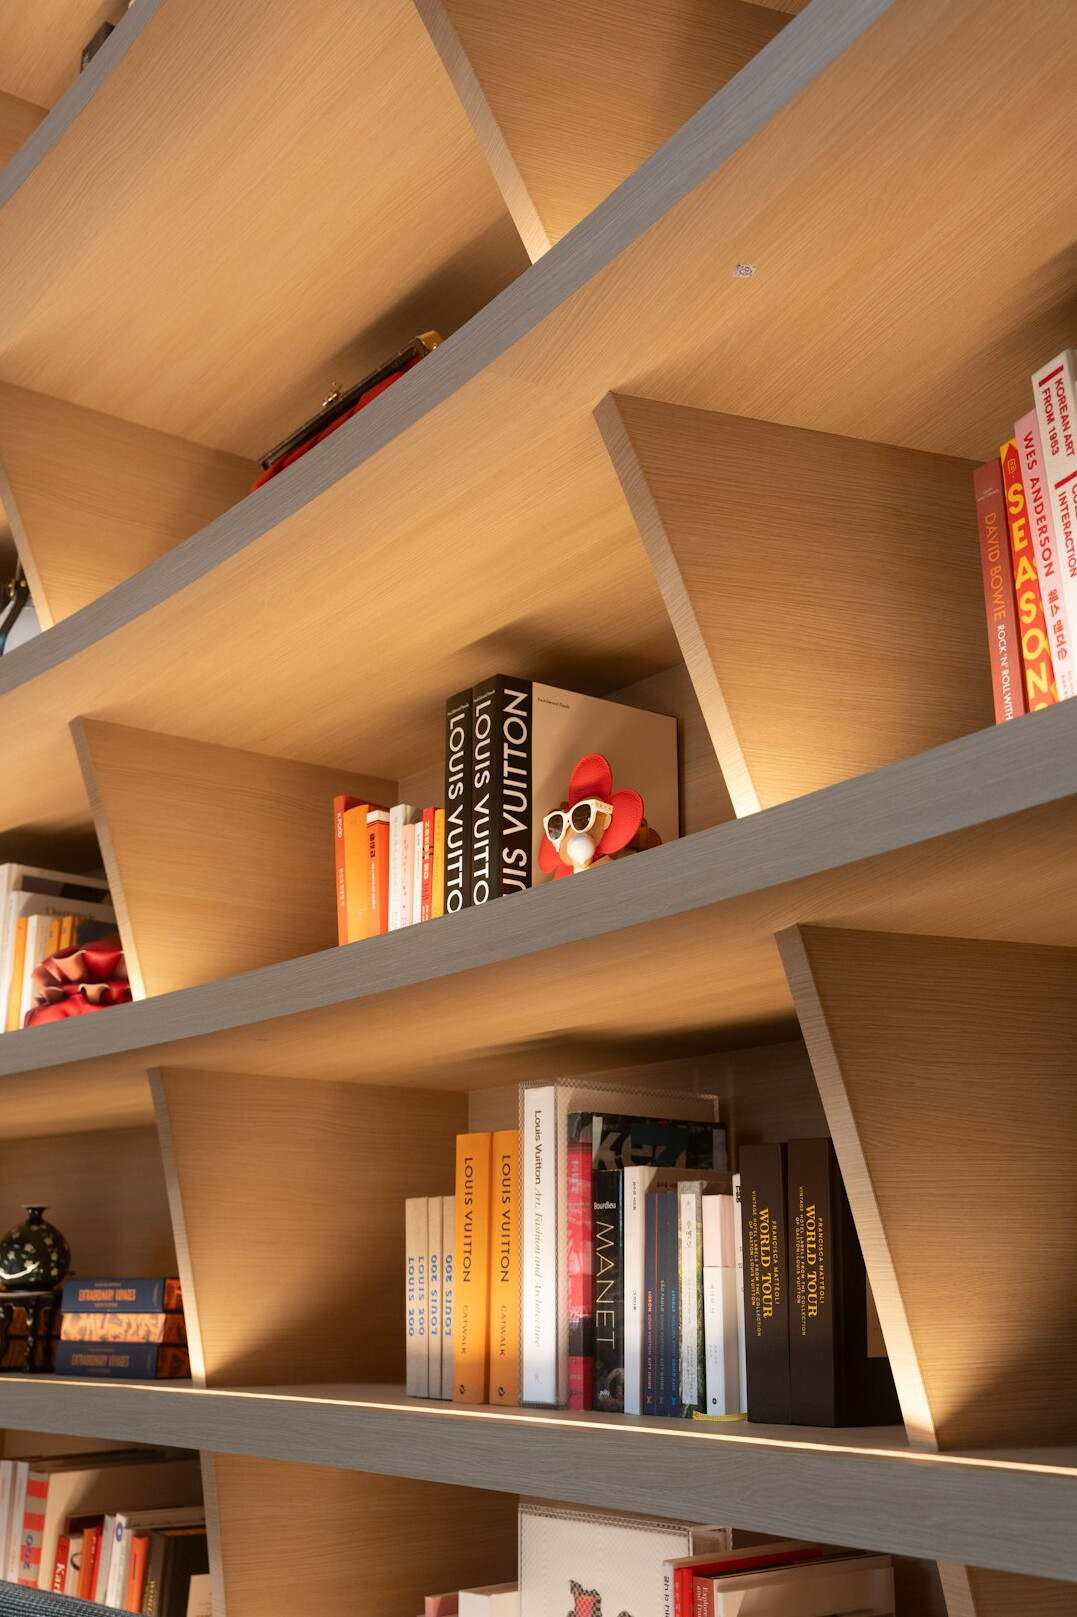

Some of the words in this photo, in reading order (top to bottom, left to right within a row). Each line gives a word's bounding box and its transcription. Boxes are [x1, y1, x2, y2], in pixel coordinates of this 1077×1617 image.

[1042, 386, 1056, 425] FROM
[1054, 378, 1070, 432] KOREAN
[1064, 434, 1076, 458] ART
[1022, 430, 1038, 471] WES
[1048, 426, 1060, 456] 1953
[984, 512, 1002, 562] DAVID
[1028, 477, 1056, 579] ANDERSON
[1058, 491, 1077, 578] INTERACTION
[990, 568, 1006, 621] BOWIE
[1047, 589, 1062, 618] 웨스
[996, 624, 1008, 653] ROCK
[1053, 619, 1068, 662] 앤더슨
[1000, 669, 1011, 692] ROLL
[1002, 692, 1014, 720] WITH
[448, 712, 466, 800] LOUIS
[474, 700, 492, 789] LOUIS
[502, 688, 529, 836] VUITTON
[446, 804, 464, 914] VUITTO
[473, 794, 490, 906] VUITTO
[534, 1110, 542, 1142] Louis
[464, 1156, 474, 1205] LOUIS
[501, 1154, 512, 1204] LOUIS
[534, 1144, 542, 1185] Vuitton
[594, 1200, 616, 1210] Bourdieu
[748, 1220, 753, 1229] OF
[795, 1217, 800, 1225] OF
[462, 1210, 473, 1282] VUITTON
[500, 1209, 511, 1282] VUITTON
[534, 1212, 542, 1254] Fashion
[759, 1207, 771, 1267] WORLD
[805, 1204, 816, 1265] WORLD
[534, 1256, 542, 1278] and
[596, 1221, 615, 1349] MANET
[761, 1272, 773, 1318] TOUR
[807, 1270, 818, 1317] TOUR
